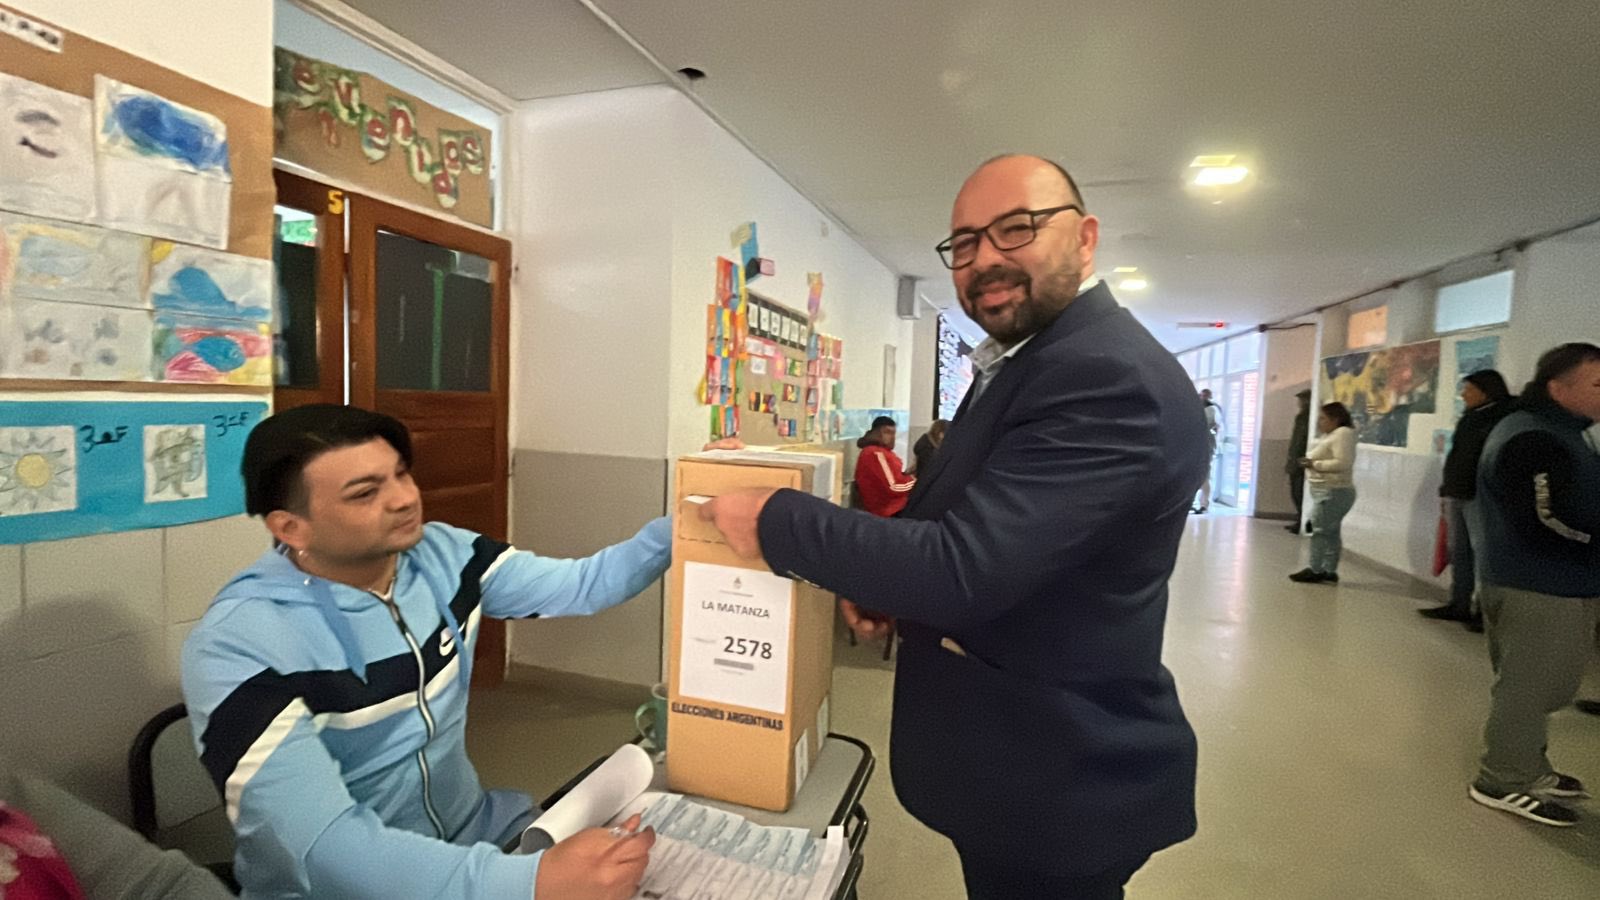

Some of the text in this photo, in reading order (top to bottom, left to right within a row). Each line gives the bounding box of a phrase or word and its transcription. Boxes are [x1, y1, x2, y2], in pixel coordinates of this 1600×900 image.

[701, 600, 771, 619] LA MATANZA
[723, 635, 773, 660] 2578
[671, 701, 784, 732] ELECCIONES ARGENTINAS
